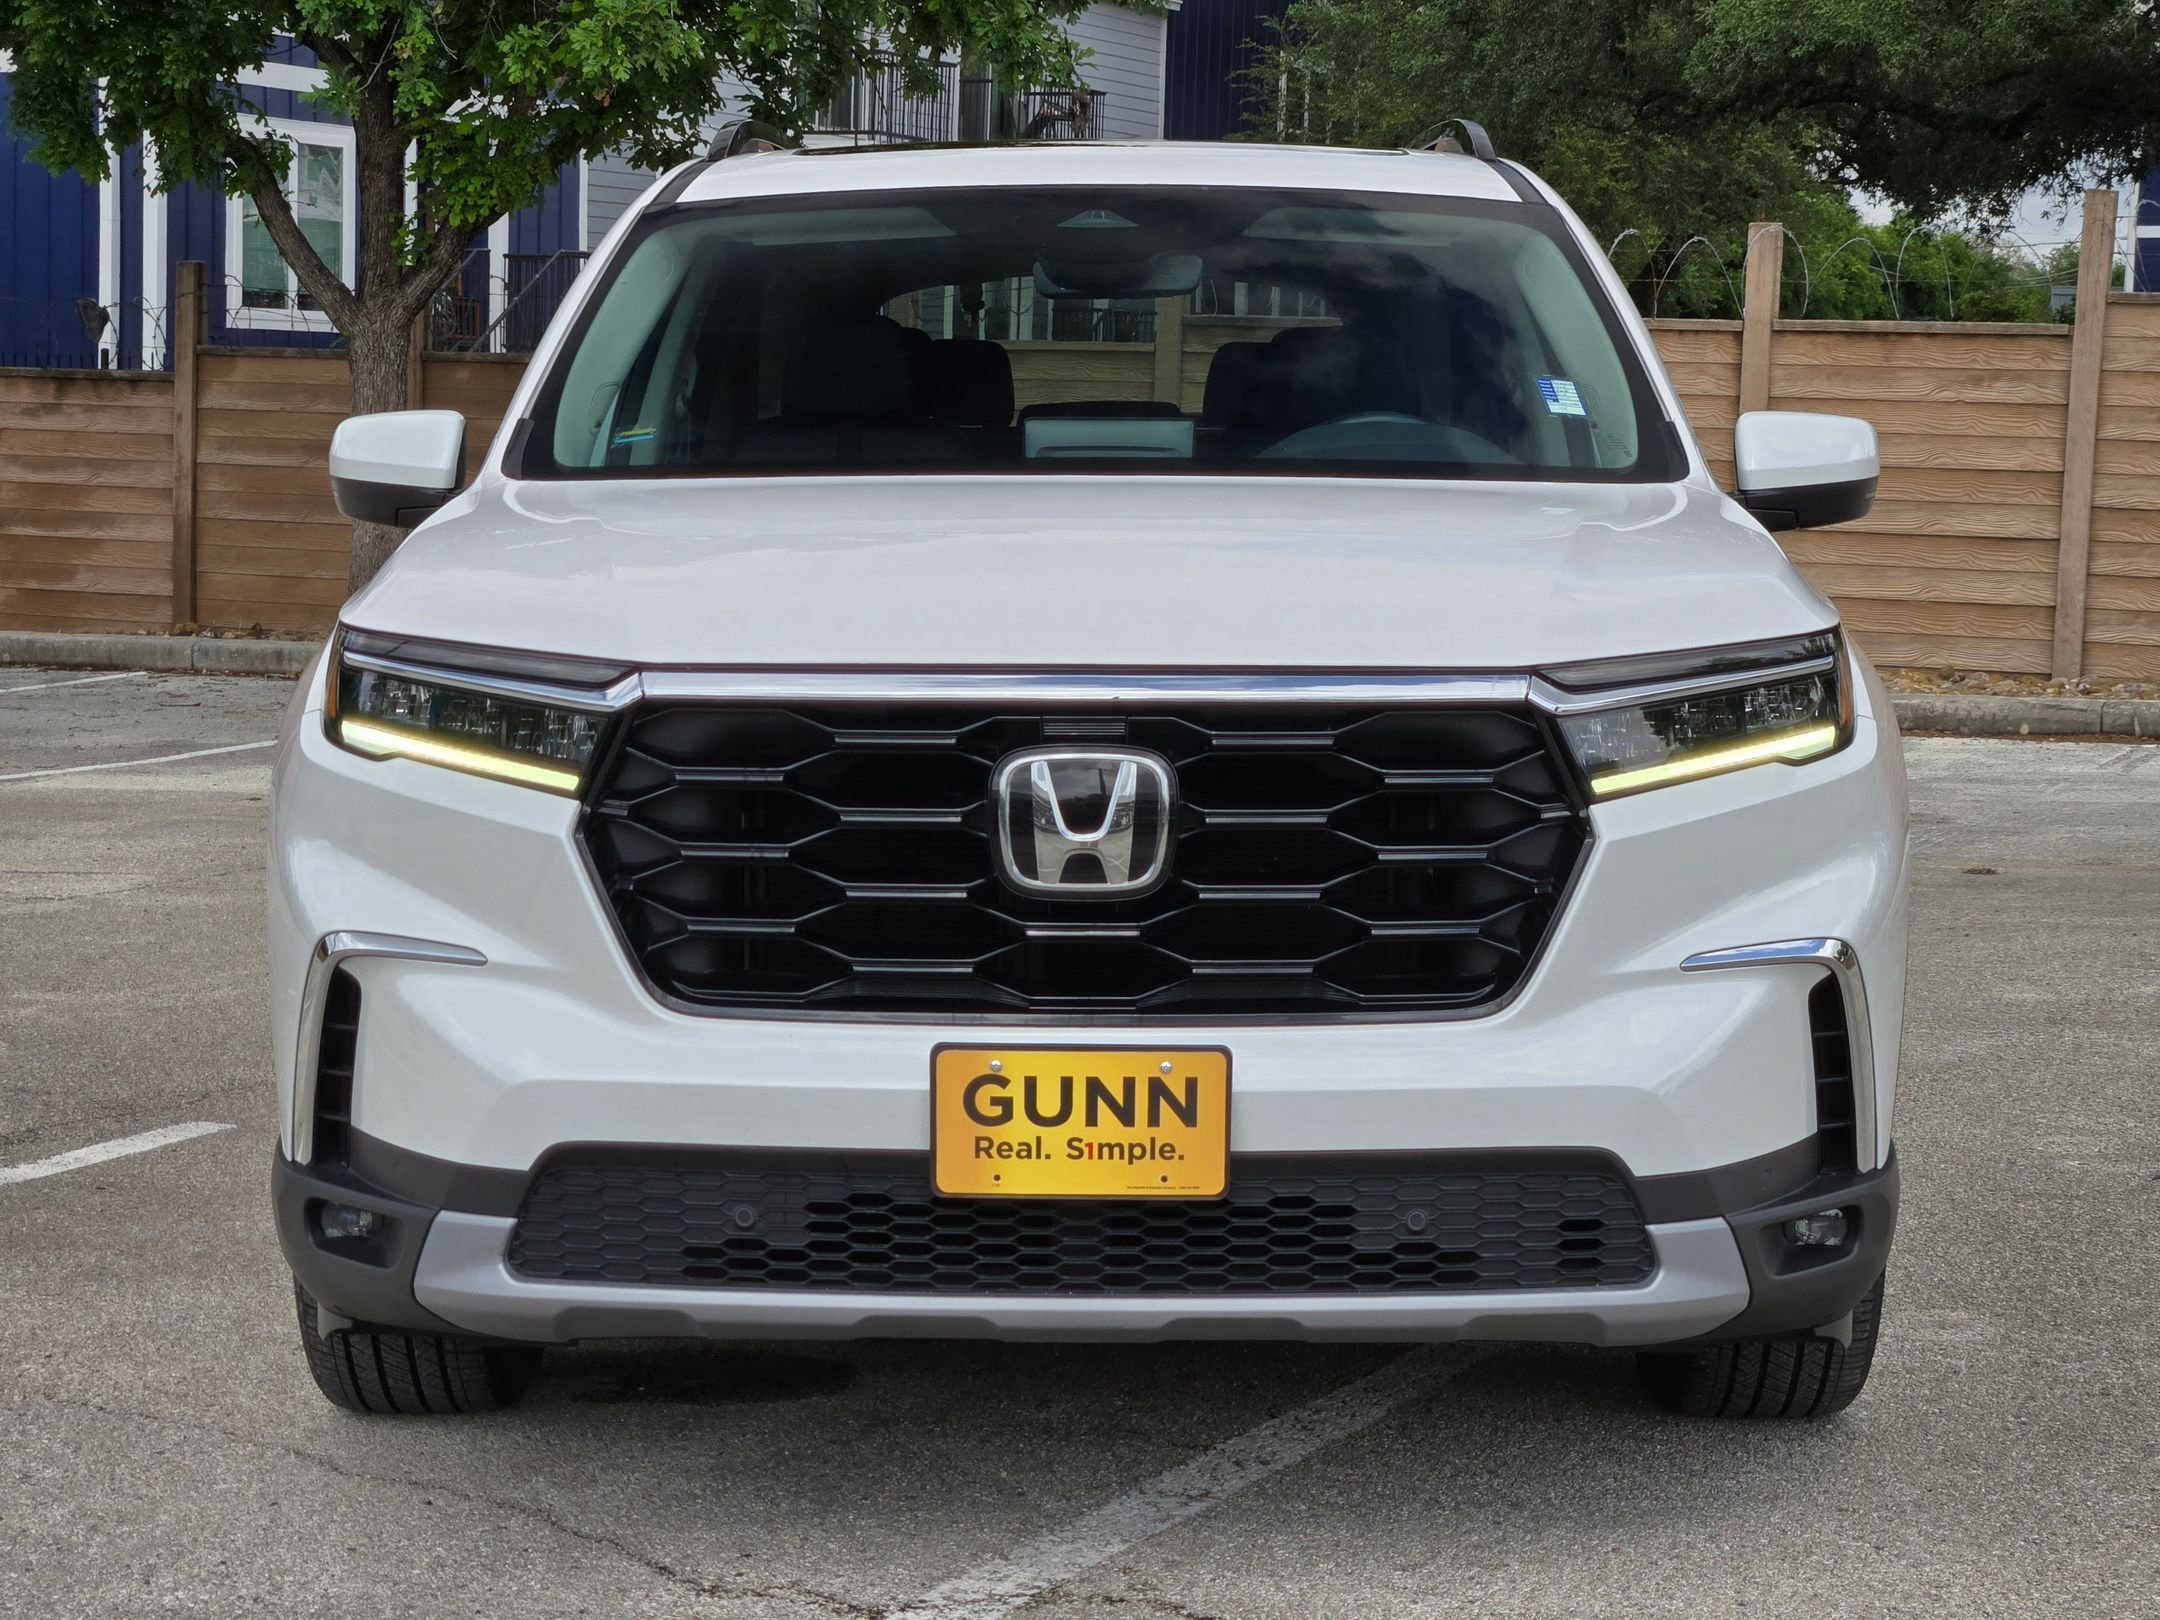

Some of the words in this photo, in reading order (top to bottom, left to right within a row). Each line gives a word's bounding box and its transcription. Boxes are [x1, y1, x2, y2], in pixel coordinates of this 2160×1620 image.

[963, 1074, 1198, 1128] GUNN
[974, 1136, 1051, 1160] Real.
[1066, 1137, 1185, 1165] S1mple.
